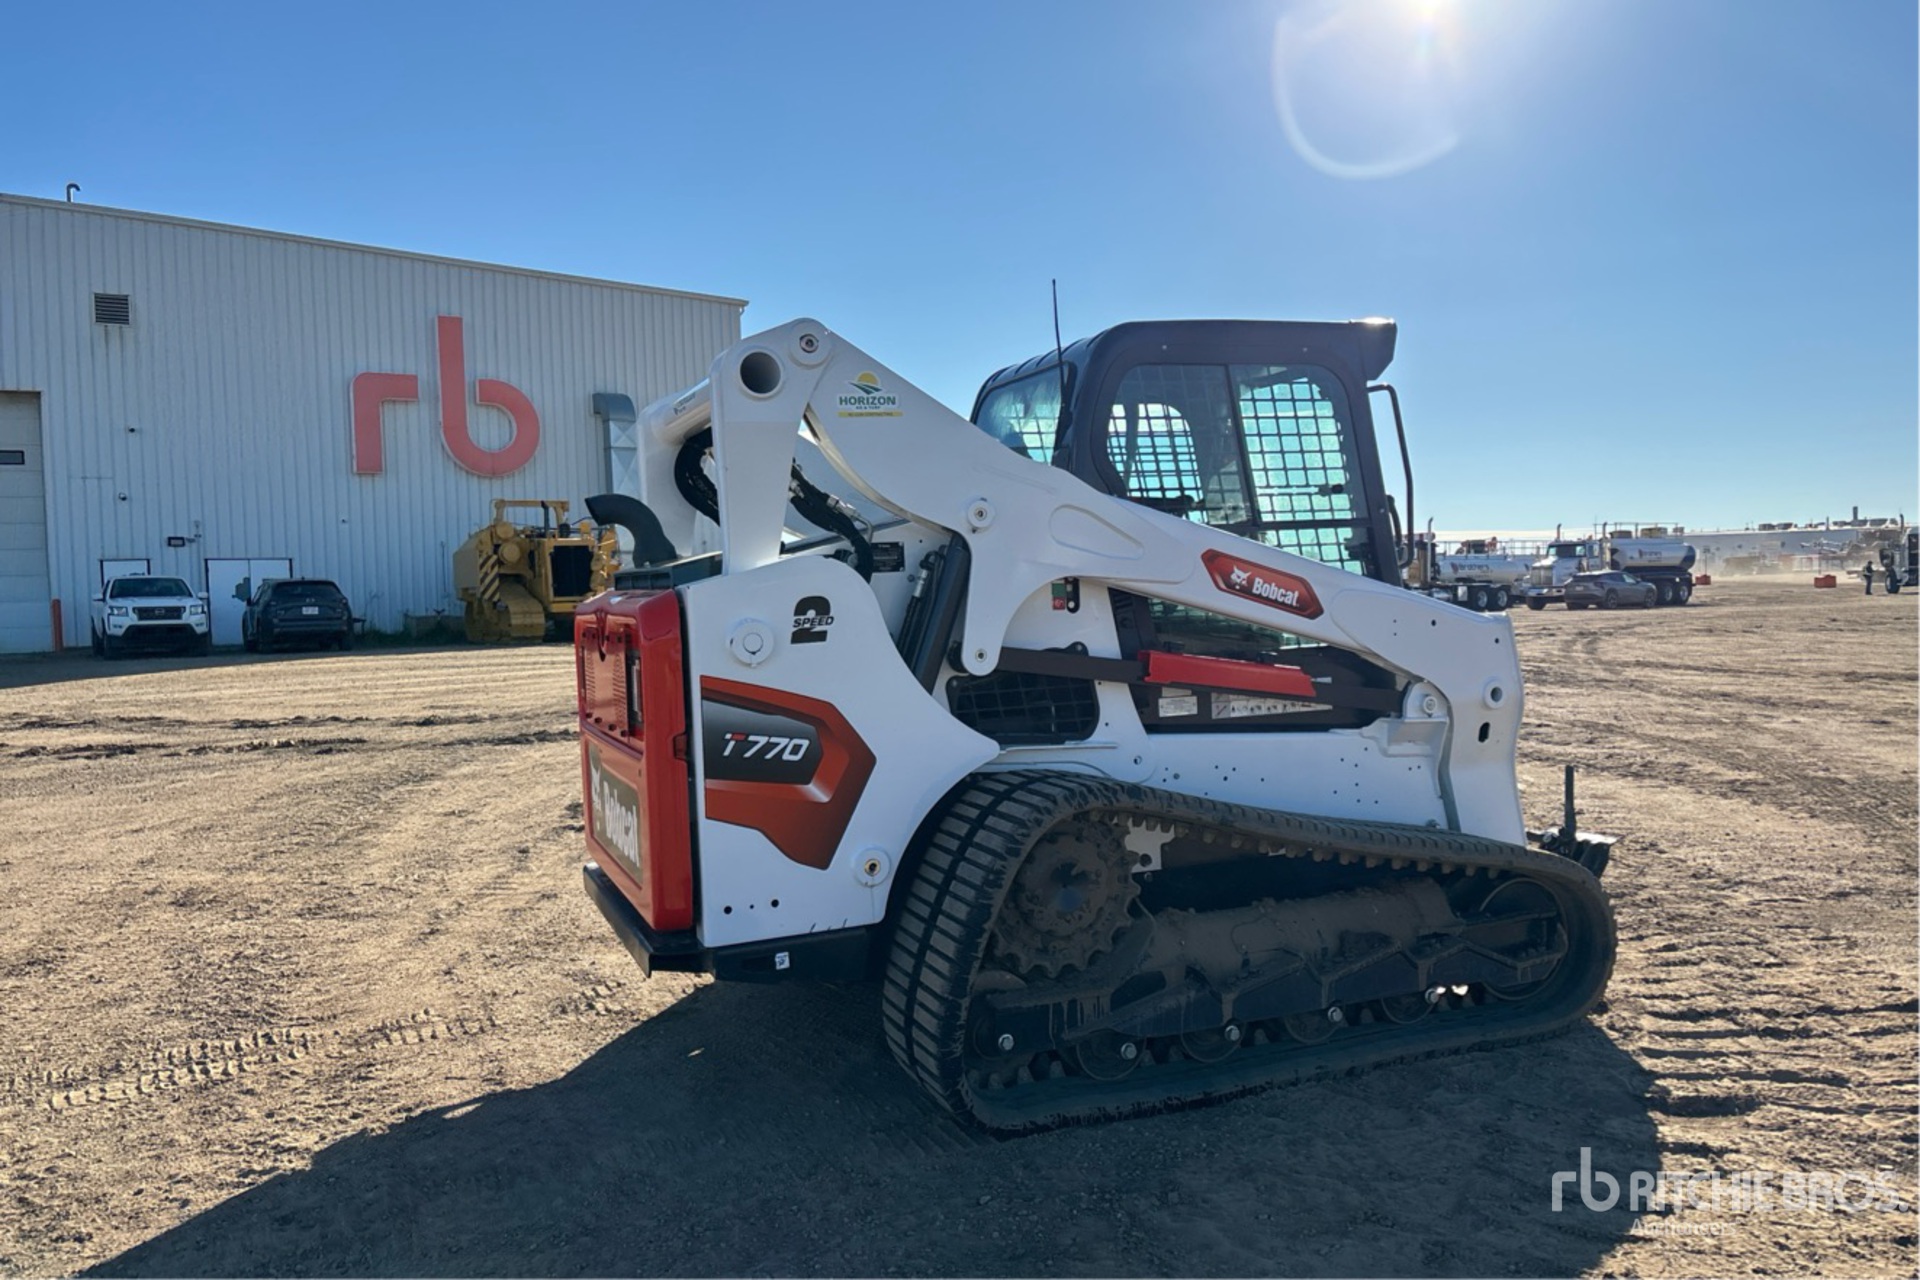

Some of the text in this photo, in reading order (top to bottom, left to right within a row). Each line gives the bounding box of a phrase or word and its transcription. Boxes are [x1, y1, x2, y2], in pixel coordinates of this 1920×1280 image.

[350, 316, 540, 478] rb
[839, 396, 896, 406] HORIZON
[1252, 577, 1300, 607] Bobcat
[790, 595, 831, 645] 2
[792, 616, 834, 628] SPEED
[722, 733, 811, 761] T770
[603, 780, 640, 868] Bobcat
